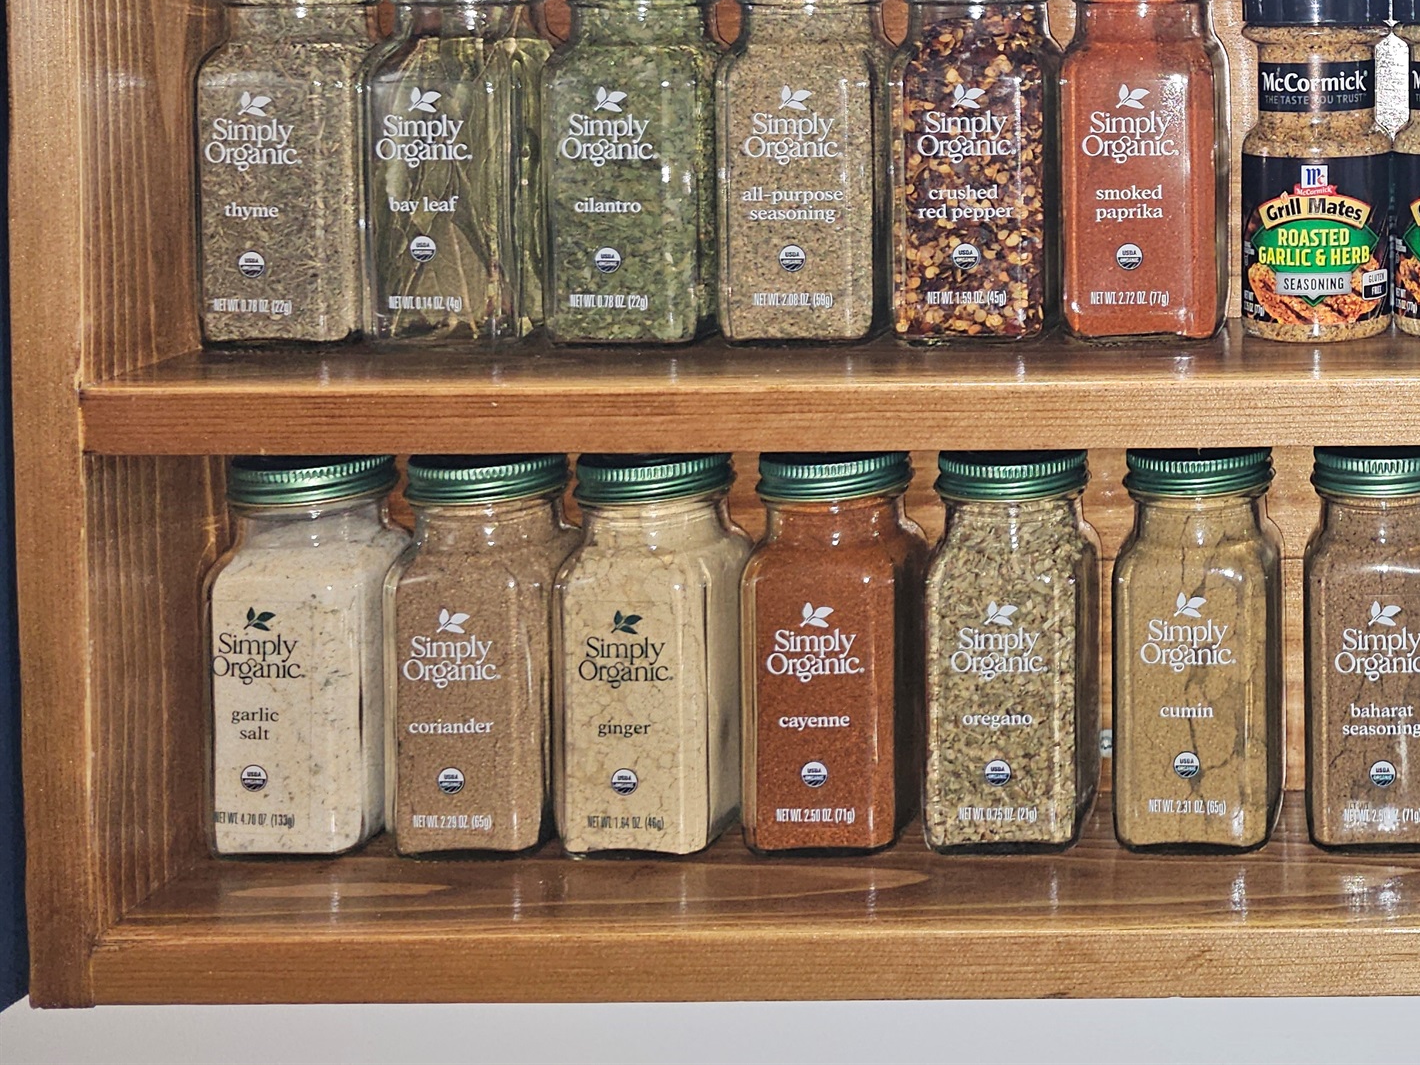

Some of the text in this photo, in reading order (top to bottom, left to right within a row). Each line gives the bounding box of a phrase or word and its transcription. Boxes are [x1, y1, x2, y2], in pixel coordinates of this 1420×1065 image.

[1262, 71, 1367, 93] McCormick
[212, 118, 294, 148] Simply
[753, 112, 834, 142] Simply
[1090, 111, 1172, 140] Simply
[742, 188, 843, 205] all-purpose
[929, 185, 998, 200] crushed
[1096, 186, 1162, 200] smoked
[225, 203, 279, 220] thyme
[389, 197, 459, 214] bay leaf
[575, 199, 642, 213] cilantro
[919, 206, 1013, 221] red pepper
[1096, 205, 1163, 222] paprika
[1266, 197, 1362, 221] Grill Mates
[750, 207, 836, 223] seasoning
[1278, 229, 1350, 246] ROASTED
[1258, 247, 1370, 265] GARLIC & HERB
[1284, 277, 1344, 290] SEASONING
[1091, 292, 1105, 304] NET
[1150, 291, 1169, 305] (77g)
[231, 708, 279, 724] garlic
[1160, 703, 1213, 718] cumin
[1350, 703, 1413, 718] baharat
[409, 720, 493, 734] coriander
[598, 720, 651, 737] ginger
[779, 714, 850, 731] cayenne
[963, 713, 1033, 728] oregano
[239, 727, 270, 740] salt
